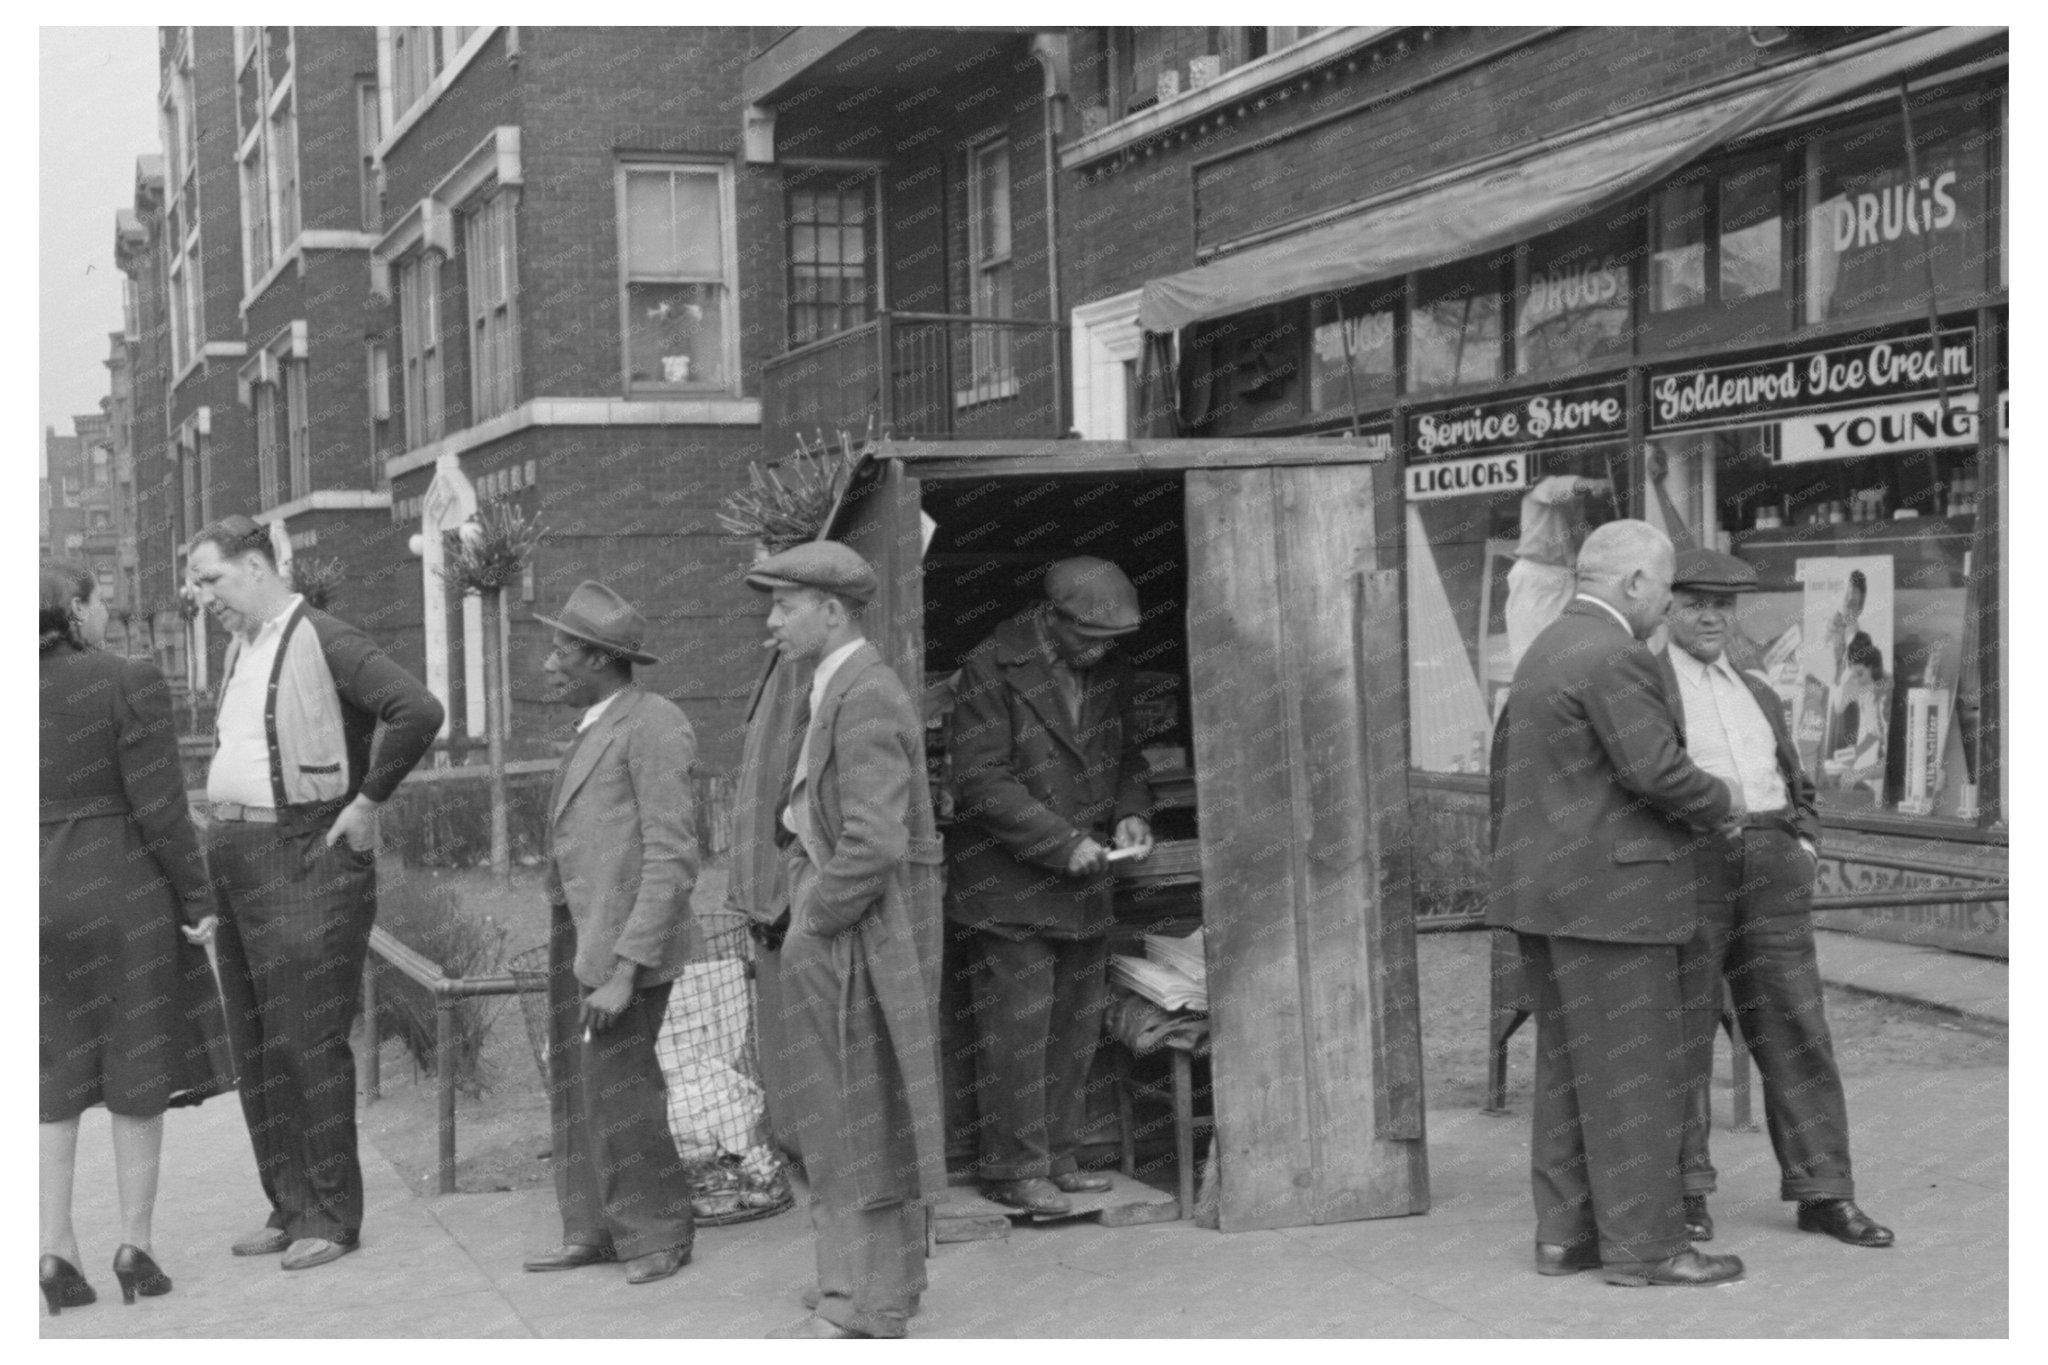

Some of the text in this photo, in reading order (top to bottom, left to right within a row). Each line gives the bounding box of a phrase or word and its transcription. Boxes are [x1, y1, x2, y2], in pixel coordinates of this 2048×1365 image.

[1834, 171, 1956, 252] DRUGS
[1530, 254, 1617, 315] DRUGS
[1655, 344, 1973, 420] Goldenrod Ice Cream
[1417, 407, 1520, 454] Service
[1527, 397, 1622, 438] Store
[1814, 405, 1971, 450] YOUNG
[1414, 459, 1519, 494] LIQUORS
